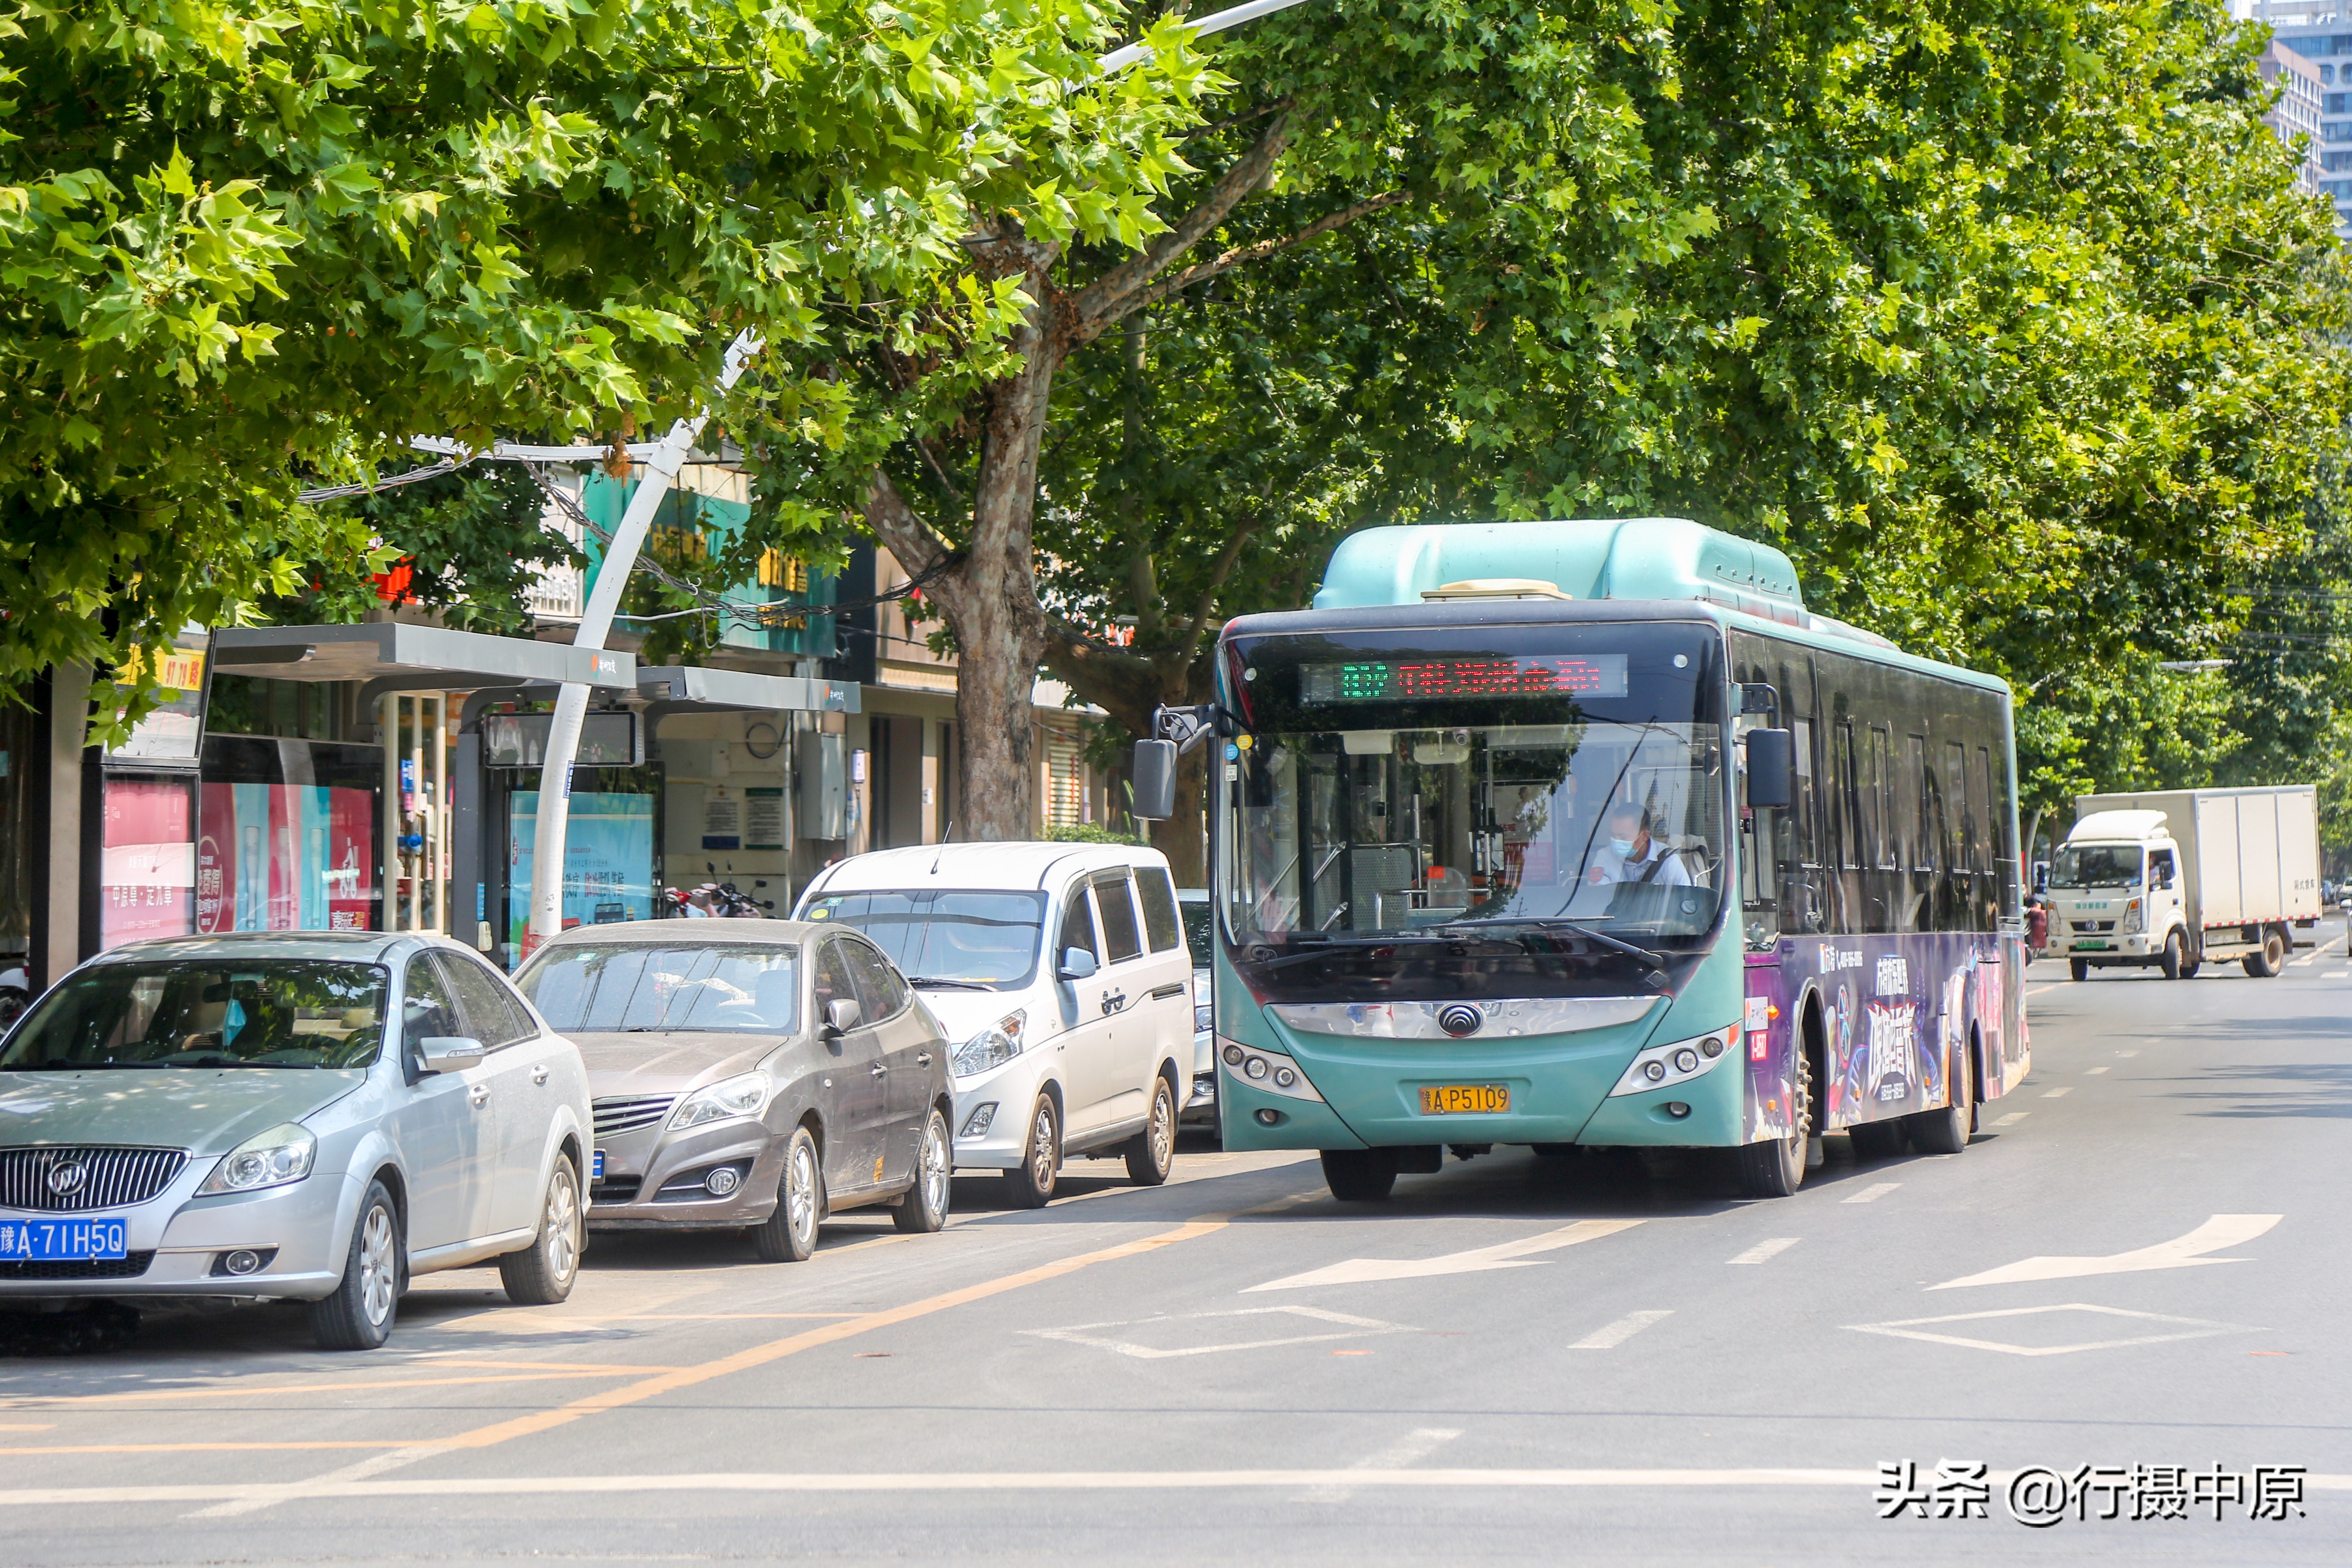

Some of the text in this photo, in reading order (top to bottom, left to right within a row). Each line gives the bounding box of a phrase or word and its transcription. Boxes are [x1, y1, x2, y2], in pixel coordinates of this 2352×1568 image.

[166, 660, 177, 684] 97
[178, 663, 188, 686] 79
[1824, 945, 1835, 972] 方特
